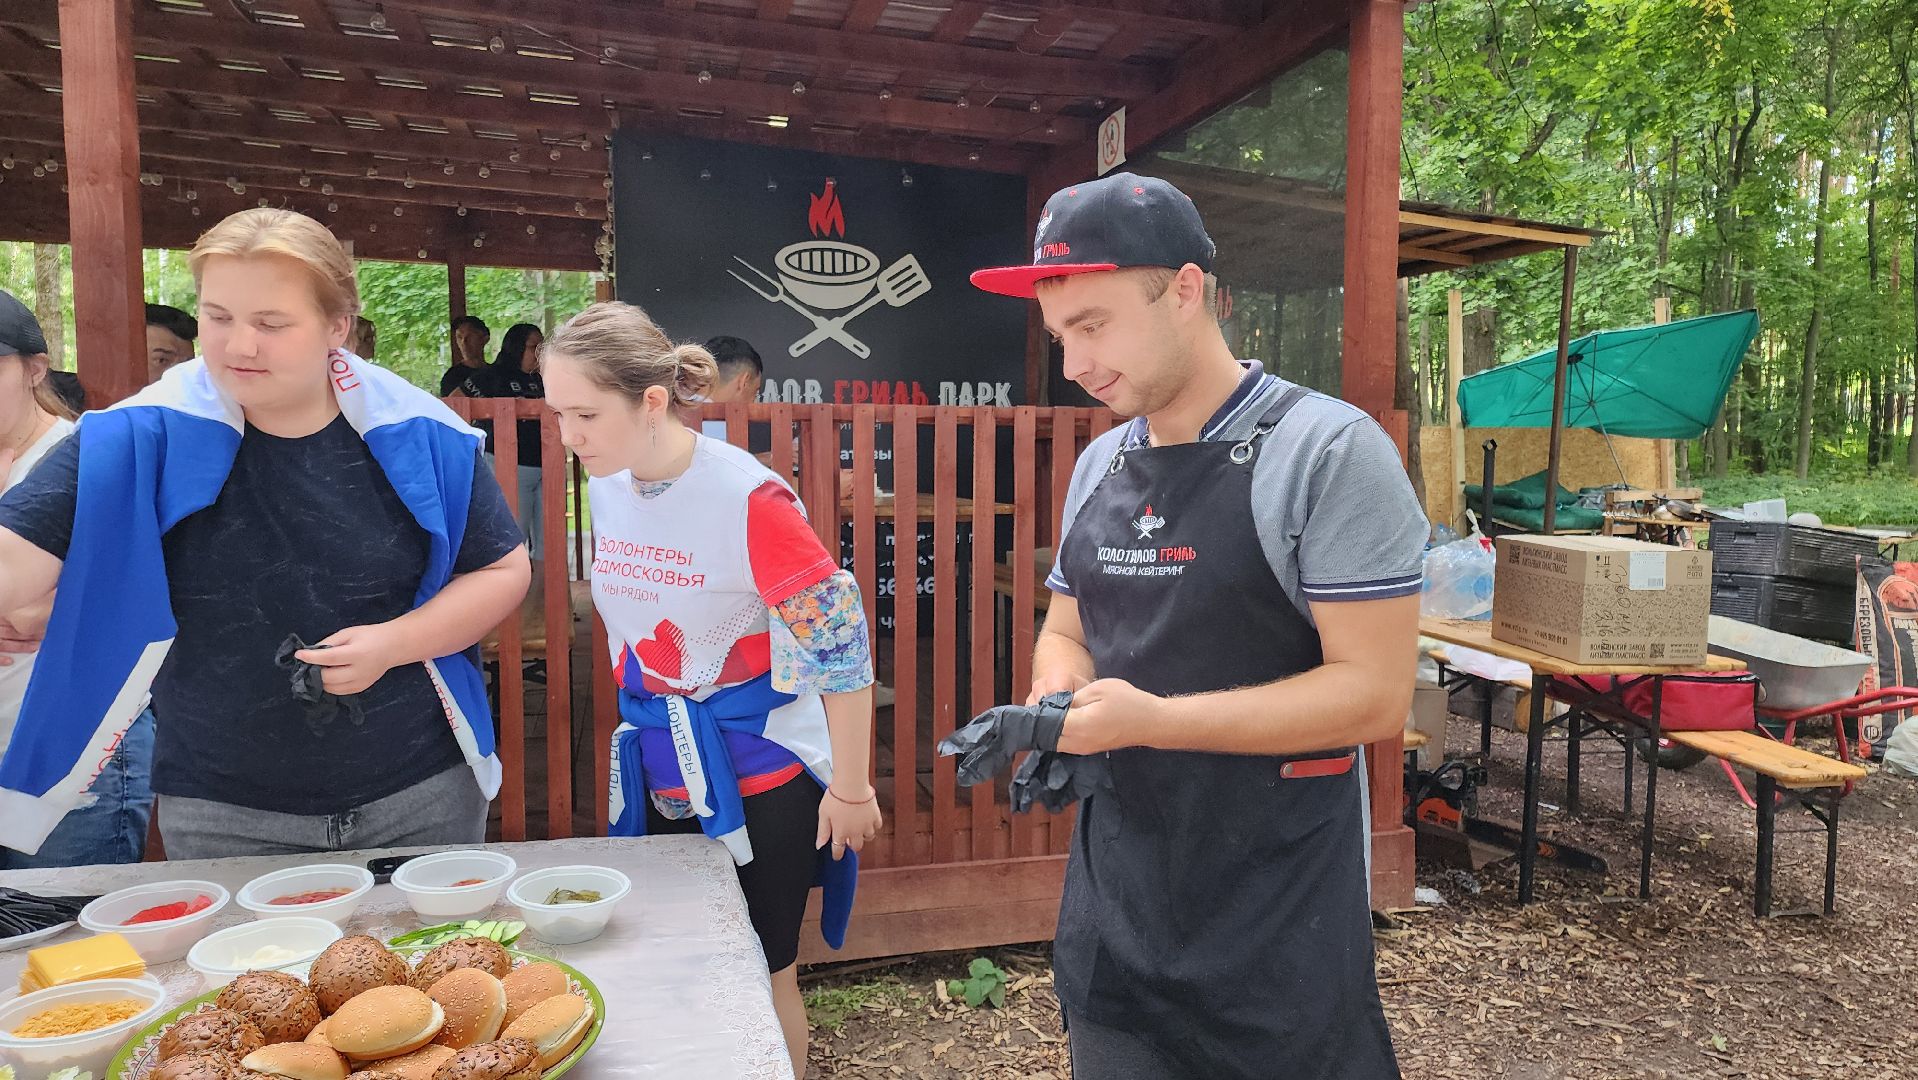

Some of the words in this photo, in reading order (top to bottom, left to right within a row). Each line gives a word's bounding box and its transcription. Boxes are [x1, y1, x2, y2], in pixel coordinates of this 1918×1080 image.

[833, 379, 929, 405] ГРИЛЬ
[937, 381, 1012, 408] ПАРК
[1097, 547, 1157, 563] КОЛОТИЛОВ
[1160, 547, 1197, 562] ГРИЛЬ
[592, 558, 705, 588] ОДМОСКОВЬЯ
[1102, 564, 1136, 576] МЯСНОЙ
[1138, 565, 1186, 577] КЕЙТЕРИНГ
[602, 583, 619, 596] МЫ
[621, 585, 659, 605] РЯДОМ
